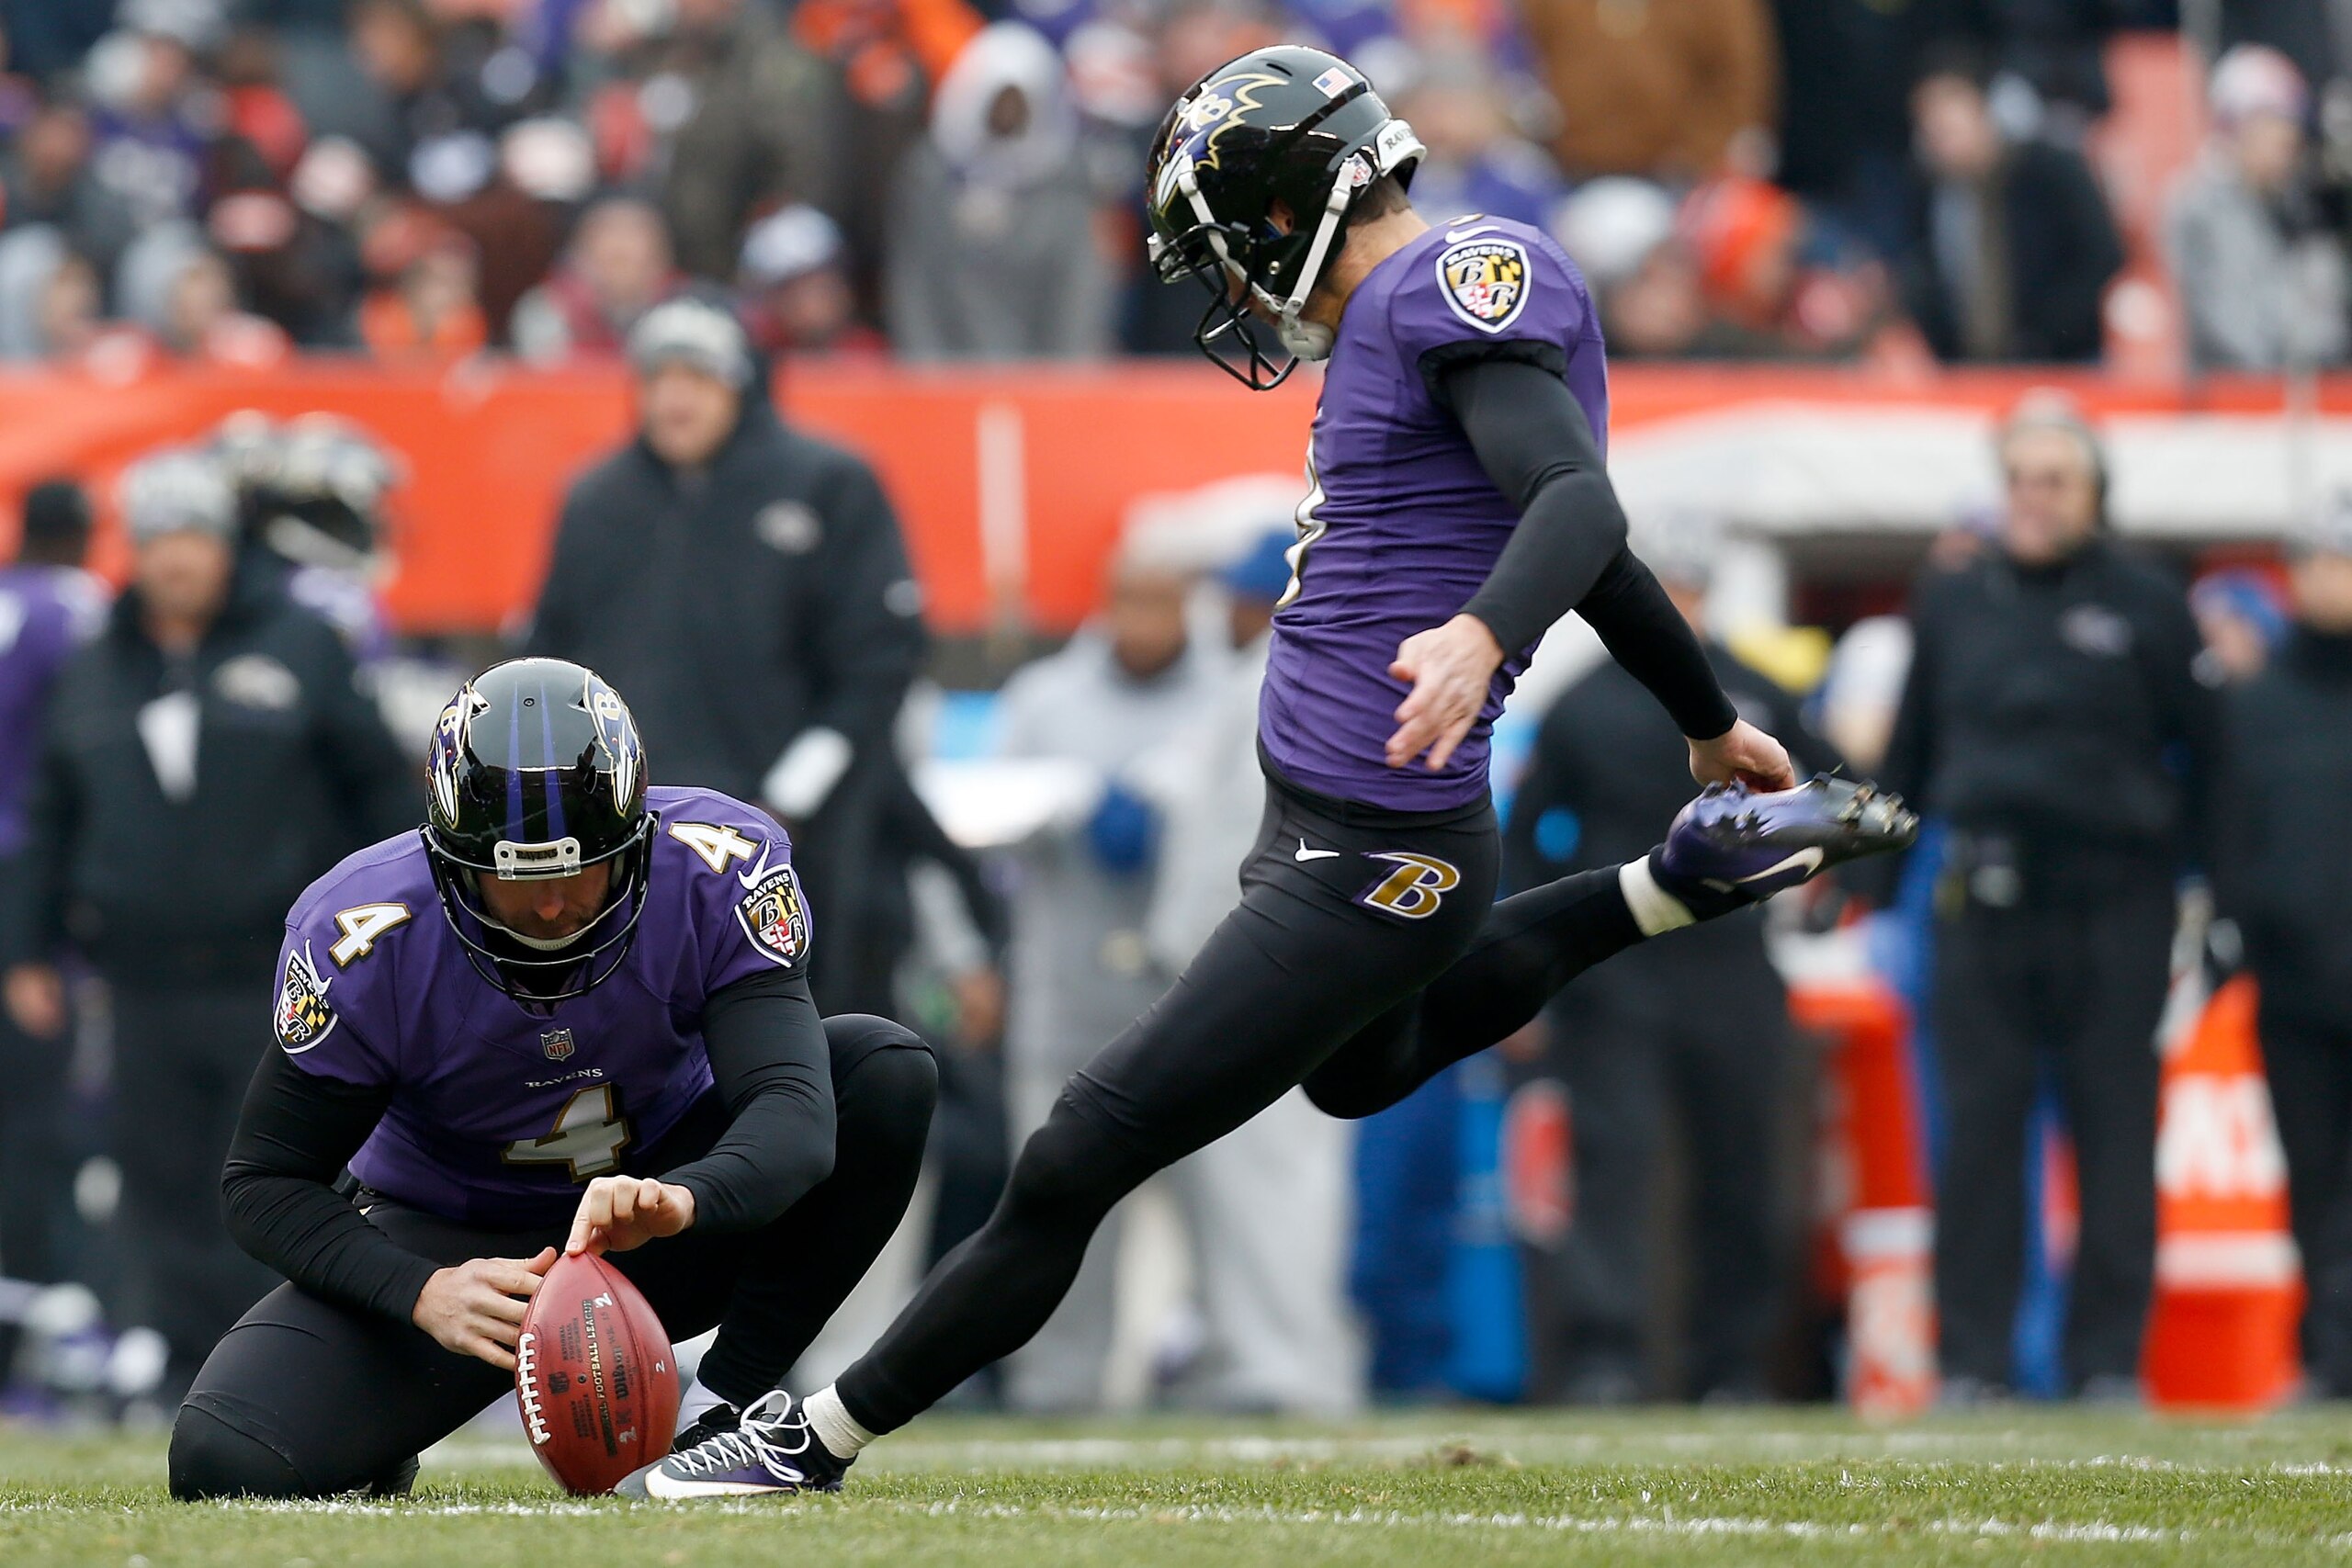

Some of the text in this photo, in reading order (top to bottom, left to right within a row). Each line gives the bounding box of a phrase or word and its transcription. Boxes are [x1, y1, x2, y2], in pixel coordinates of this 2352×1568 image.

[1444, 245, 1516, 266] RAVENS
[514, 847, 559, 862] RAVENS
[667, 822, 759, 874] 4
[741, 872, 791, 909] RAVENS
[1363, 852, 1461, 919] B
[327, 902, 413, 969] 4
[290, 959, 330, 1010] RAVENS
[548, 1043, 571, 1056] NFL
[524, 1067, 604, 1089] RAVENS
[500, 1081, 632, 1185] 4
[594, 1292, 614, 1309] 2
[582, 1300, 618, 1458] ONAL FOOTBALL LEAGUE
[656, 1359, 666, 1374] 2
